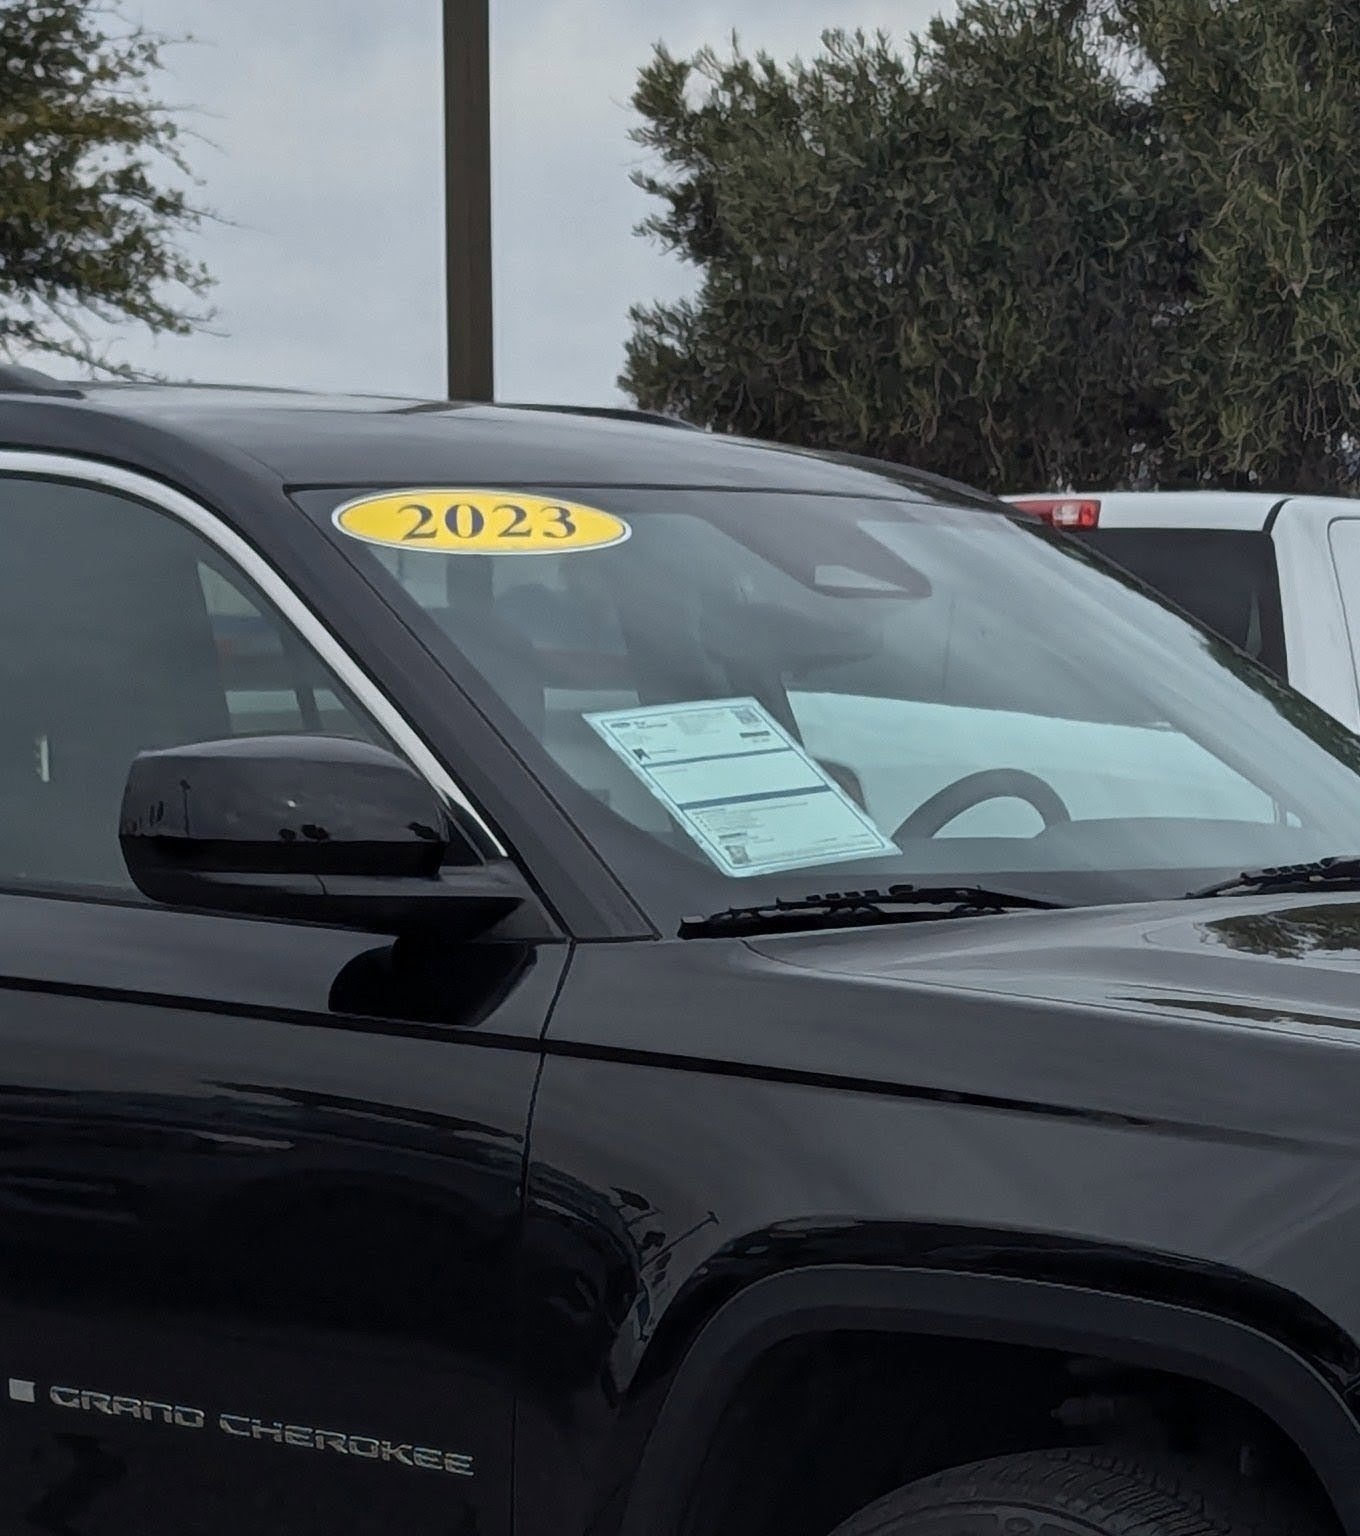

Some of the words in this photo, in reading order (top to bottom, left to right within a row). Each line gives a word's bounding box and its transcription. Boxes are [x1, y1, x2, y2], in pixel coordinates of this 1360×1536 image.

[397, 503, 577, 541] 2023
[49, 1384, 206, 1429] GRAND
[218, 1412, 475, 1477] CHEROKEE
